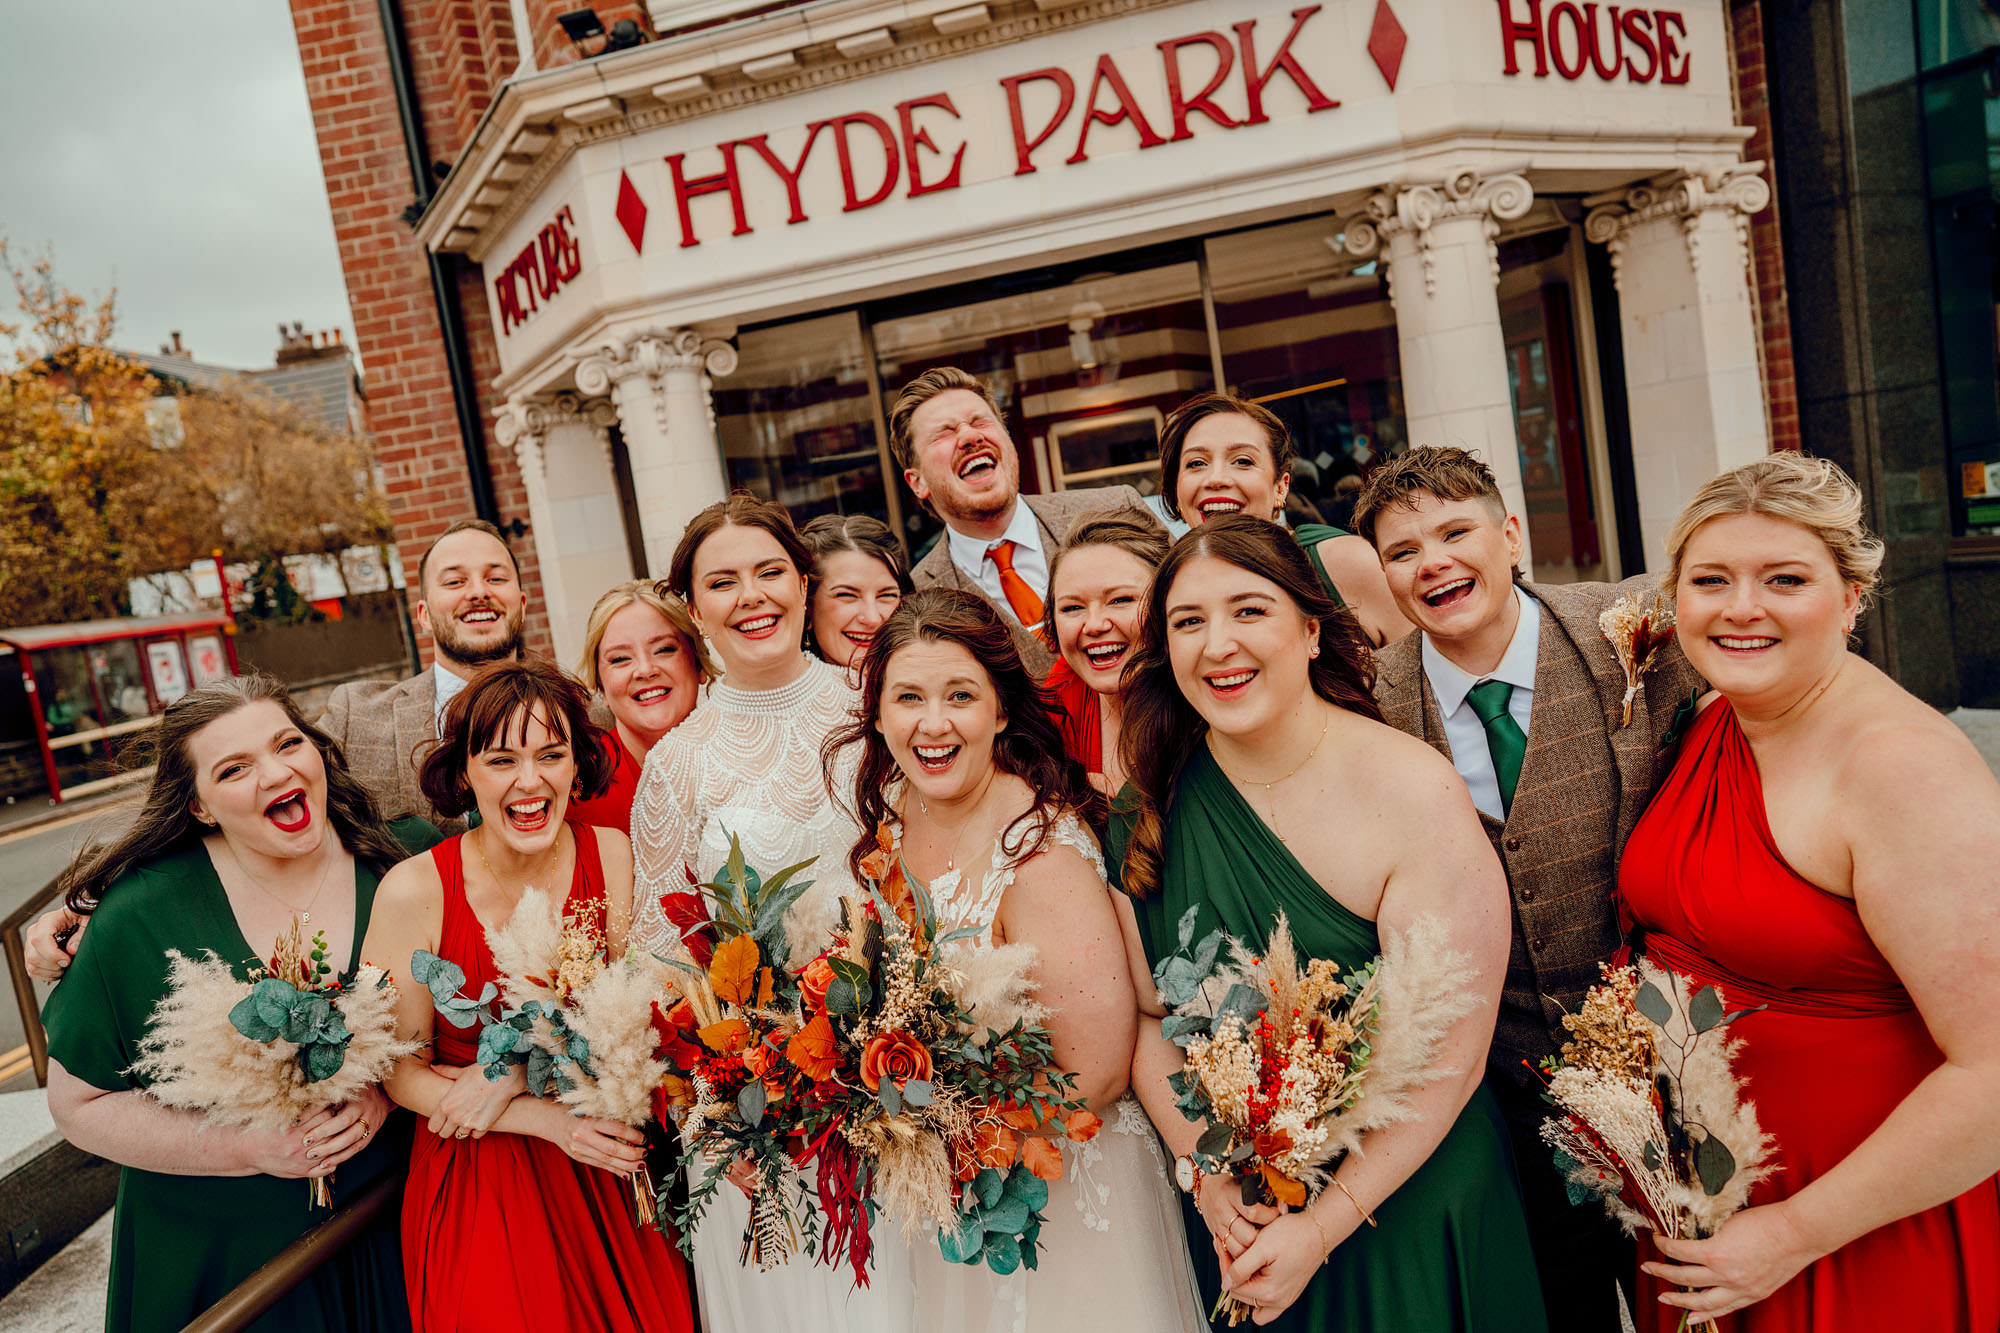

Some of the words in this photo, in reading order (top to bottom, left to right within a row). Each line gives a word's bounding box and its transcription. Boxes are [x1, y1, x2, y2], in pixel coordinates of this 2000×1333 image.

[1497, 0, 1692, 84] HOUSE
[664, 93, 966, 247] HYDE
[999, 4, 1341, 175] PARK
[495, 204, 582, 336] PICTURE
